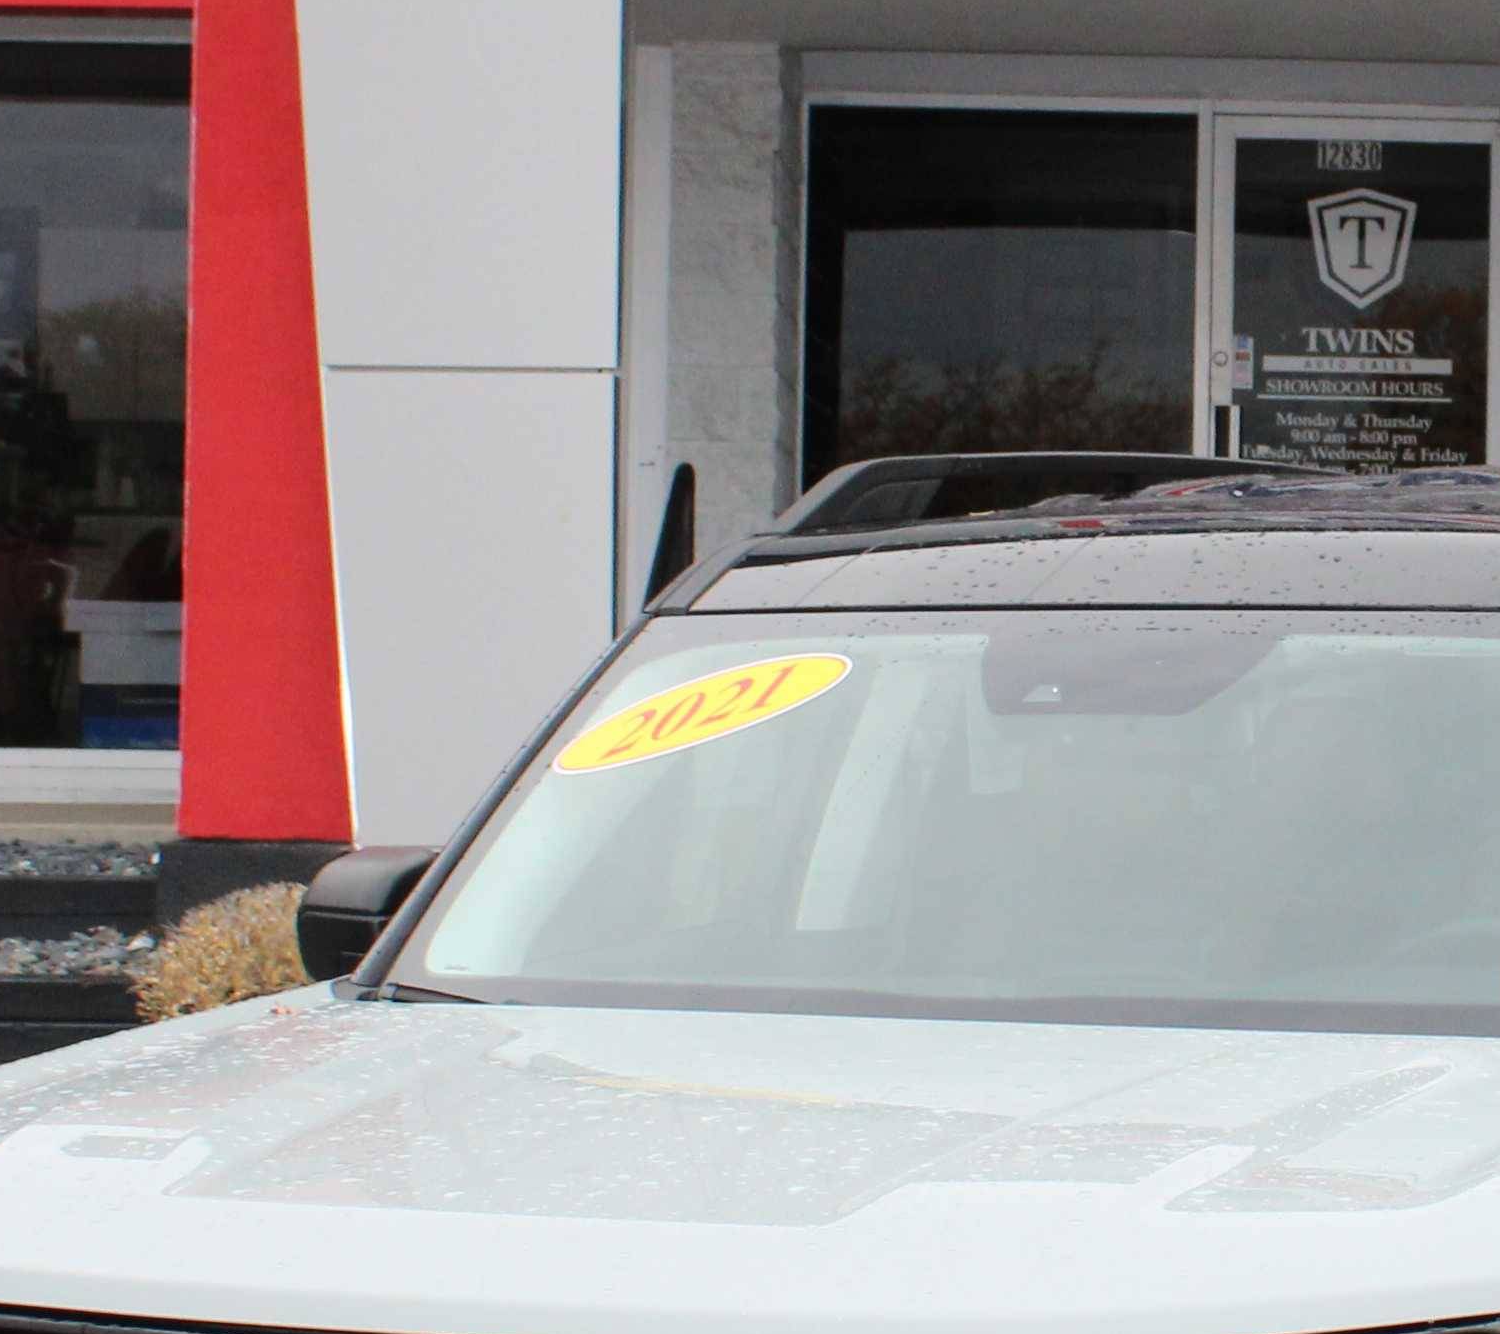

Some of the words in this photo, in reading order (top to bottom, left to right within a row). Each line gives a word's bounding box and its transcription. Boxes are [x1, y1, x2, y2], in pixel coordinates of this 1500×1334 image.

[1318, 141, 1381, 169] 12830
[1339, 215, 1385, 269] T
[1301, 327, 1415, 355] TWINS
[1265, 378, 1377, 397] SHOWROOM
[1382, 380, 1444, 397] HOURS
[1275, 411, 1340, 432] Monday
[1344, 414, 1358, 428] &
[1362, 413, 1433, 433] Thursday
[1290, 430, 1320, 444] 9:00
[1323, 433, 1347, 444] am
[1360, 431, 1389, 444] 8:00
[1392, 433, 1418, 448] pm
[1311, 445, 1397, 463] Wednesday
[1403, 448, 1416, 461] &
[1421, 447, 1468, 464] Friday
[599, 663, 799, 760] 2021
